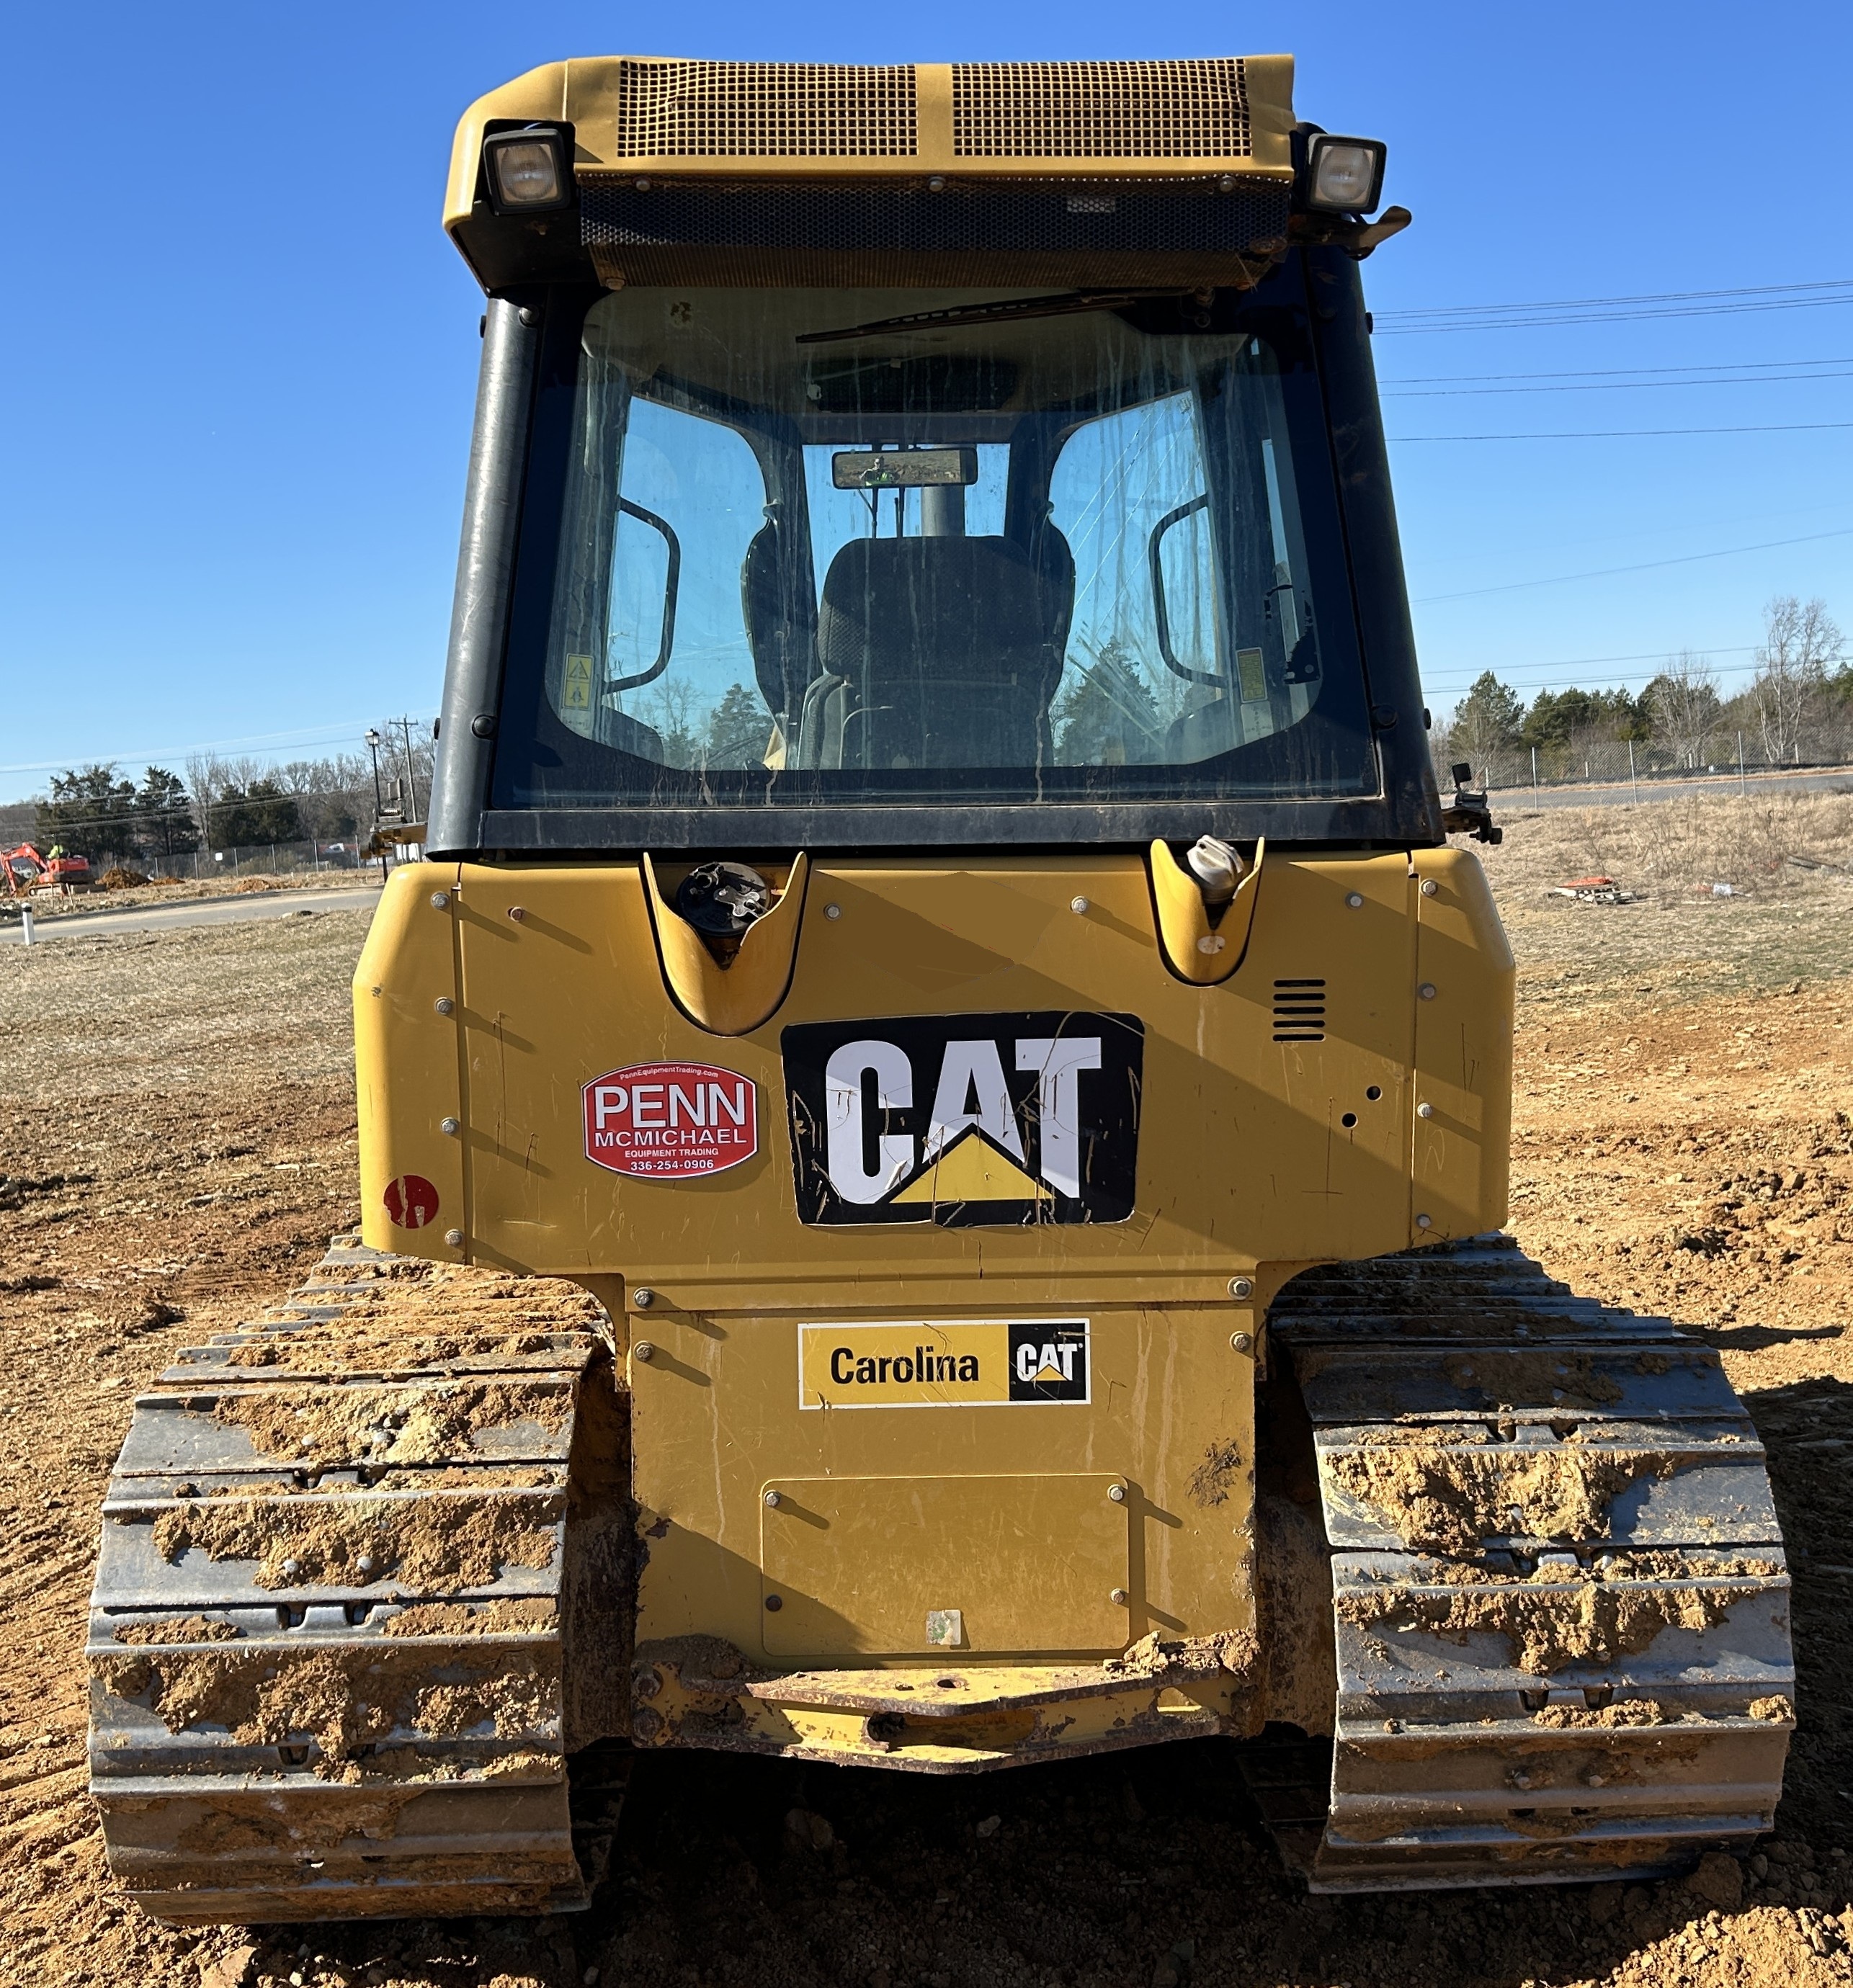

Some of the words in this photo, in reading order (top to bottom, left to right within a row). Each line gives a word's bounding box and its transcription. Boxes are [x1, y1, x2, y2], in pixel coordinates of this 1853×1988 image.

[620, 1066, 718, 1080] PennEquipmentTrading.com
[594, 1083, 746, 1129] PENN
[826, 1037, 1102, 1204] CAT
[594, 1129, 748, 1147] MCMICHAEL
[625, 1150, 676, 1158] EQUIPMENT
[630, 1160, 714, 1170] 336-254-0906
[831, 1346, 978, 1384] Carolina
[1017, 1343, 1078, 1382] CAT
